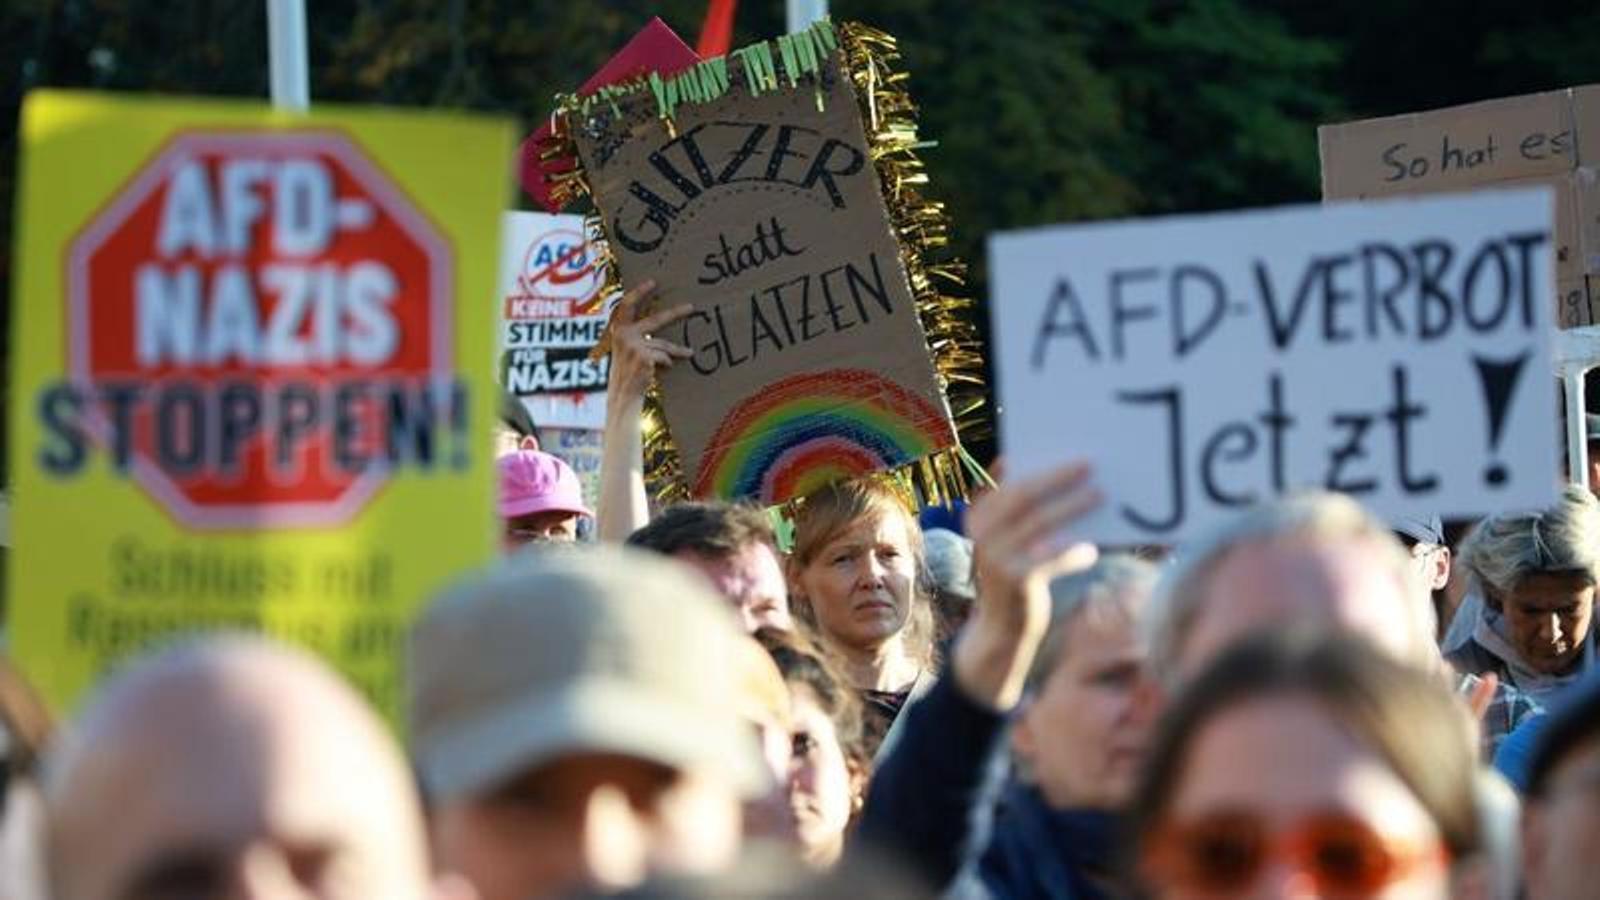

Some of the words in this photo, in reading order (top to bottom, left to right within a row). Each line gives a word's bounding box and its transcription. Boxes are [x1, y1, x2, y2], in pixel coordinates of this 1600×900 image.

[613, 121, 865, 253] GLITZER
[1381, 143, 1429, 182] So
[1441, 136, 1498, 171] hat
[155, 159, 378, 259] AFD-
[698, 217, 806, 284] statt
[135, 261, 399, 367] NAZIS
[509, 321, 606, 343] STIMME
[684, 255, 894, 376] GLATZEN
[1031, 231, 1549, 371] AFD-VERBOT
[508, 356, 609, 392] NAZIS!
[38, 378, 471, 476] STOPPEN!
